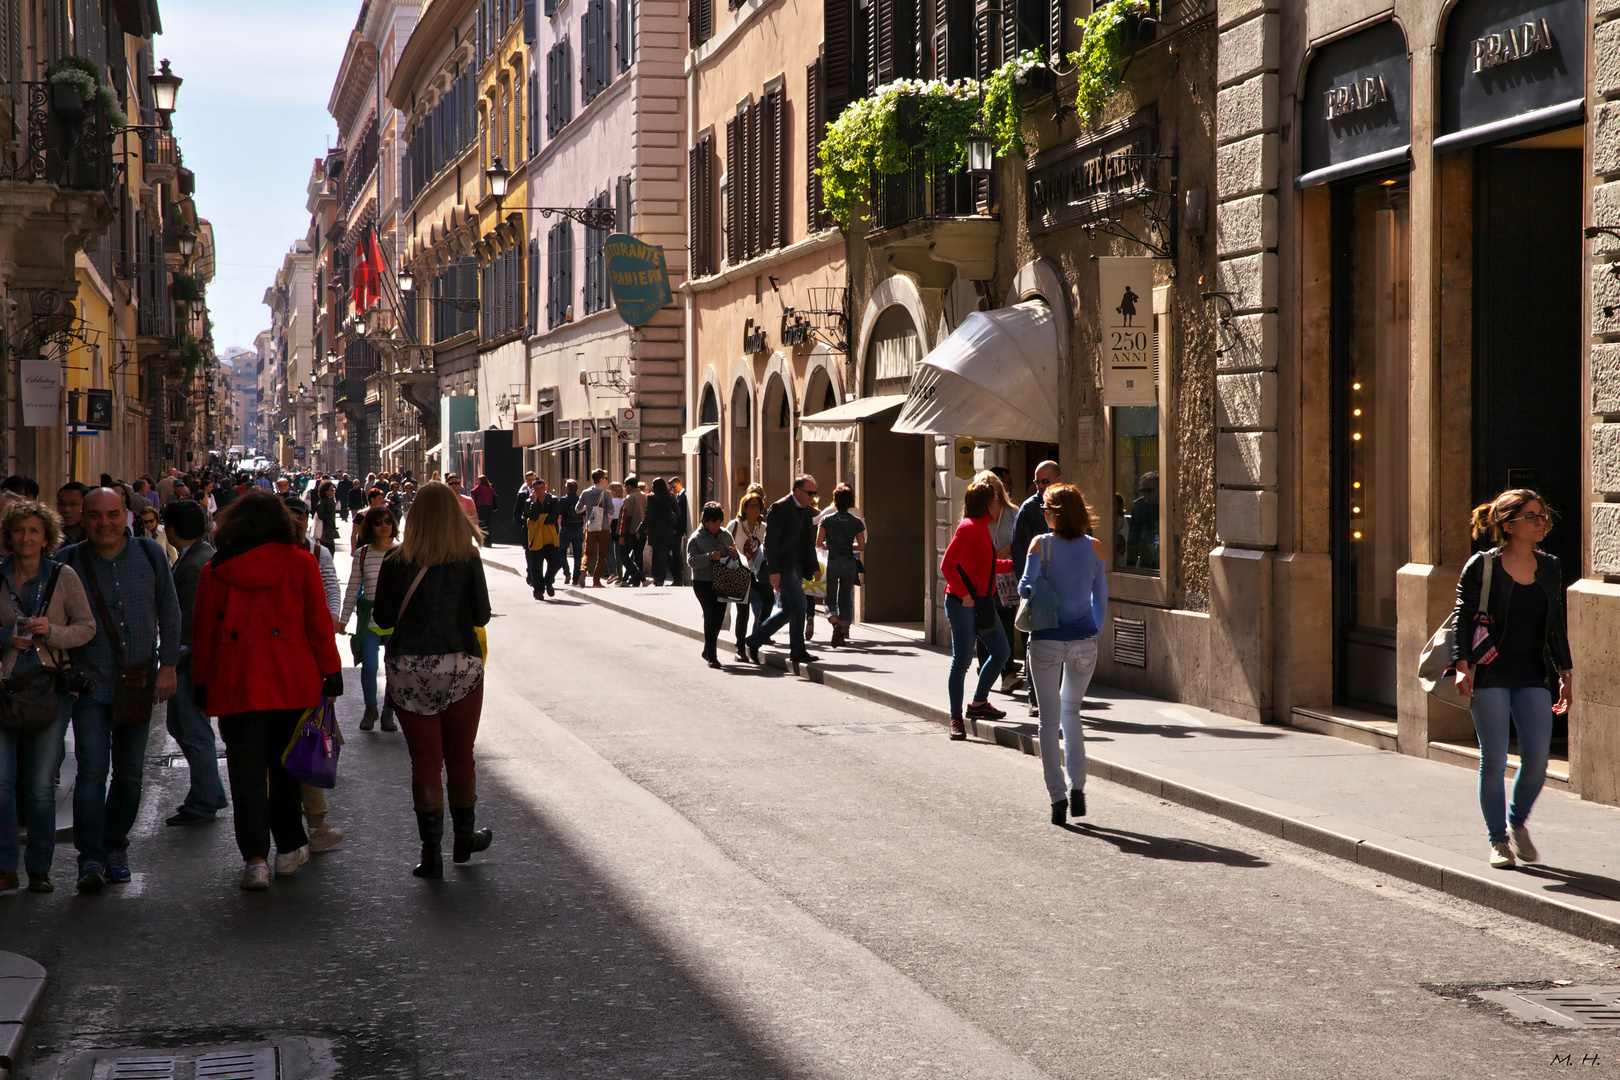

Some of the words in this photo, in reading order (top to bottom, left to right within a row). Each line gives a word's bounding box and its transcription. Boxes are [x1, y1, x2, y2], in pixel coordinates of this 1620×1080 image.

[1470, 18, 1553, 73] PRADA
[1324, 74, 1387, 120] PRADA
[605, 242, 663, 266] STORANTE
[612, 268, 662, 286] RANIERI
[1111, 331, 1147, 351] 250
[1111, 352, 1147, 362] ANNI
